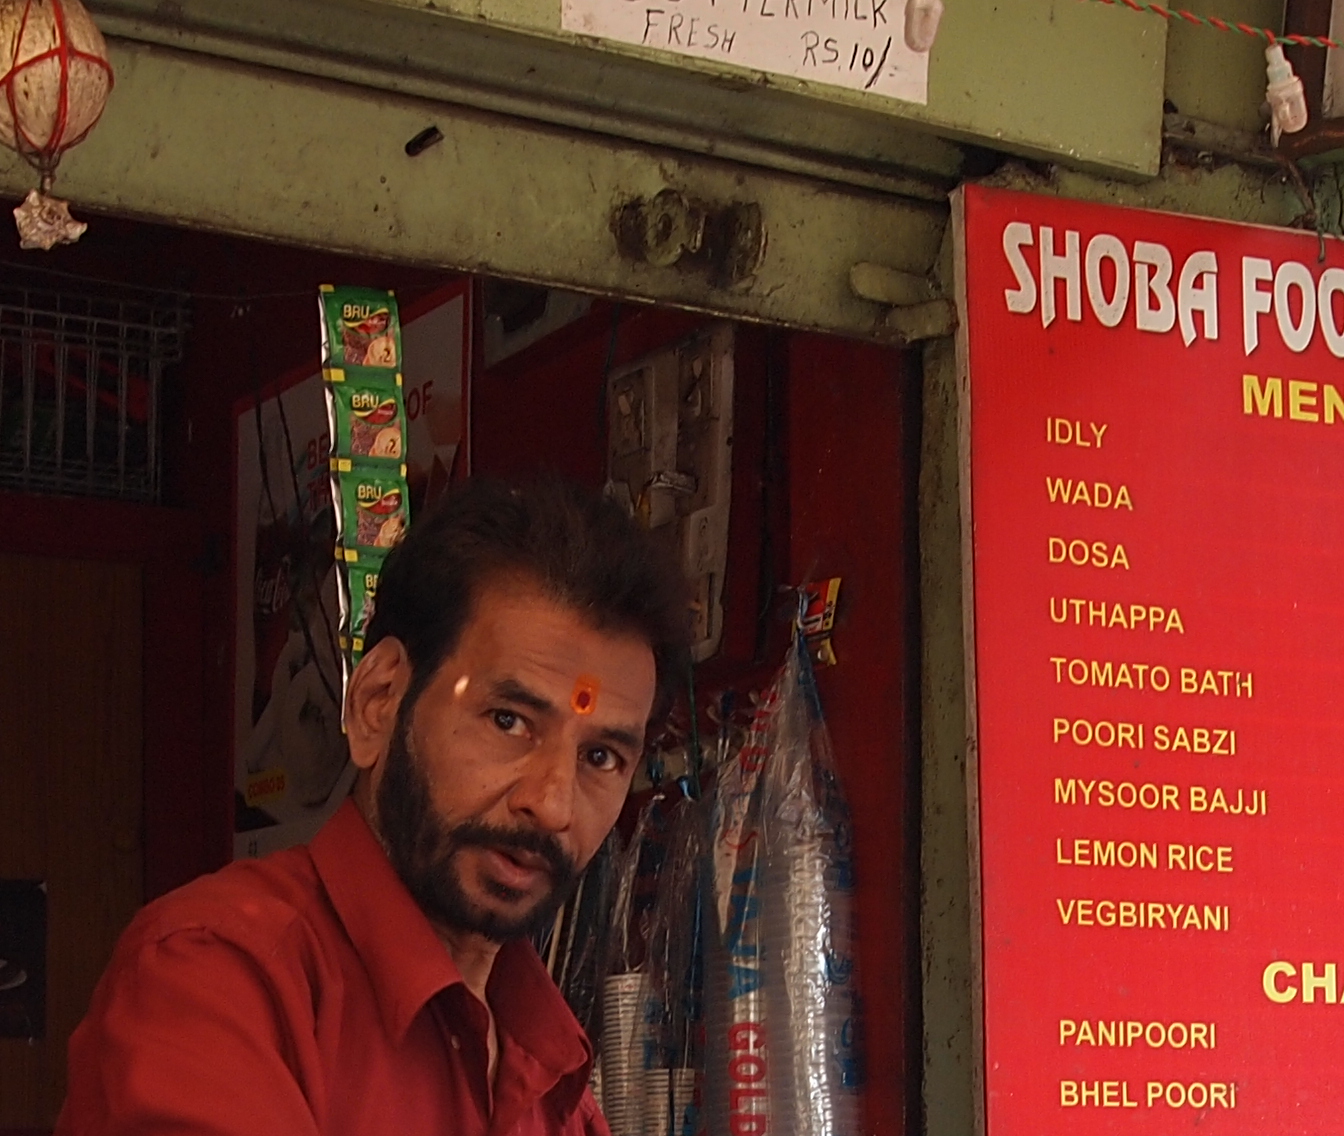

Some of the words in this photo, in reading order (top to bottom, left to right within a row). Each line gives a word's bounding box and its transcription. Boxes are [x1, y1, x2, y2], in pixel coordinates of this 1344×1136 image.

[641, 8, 737, 53] FRESH
[1003, 222, 1218, 347] SHOBA
[343, 304, 370, 319] BRU
[352, 394, 380, 409] BRU
[1047, 418, 1107, 448] IDLY
[357, 485, 382, 499] BRU
[1046, 477, 1133, 511] WADA
[1049, 537, 1130, 570] DOSA
[1050, 597, 1184, 634] UTHAPPA
[1050, 657, 1170, 691] TOMATO
[1180, 668, 1253, 698] BATH
[1053, 718, 1144, 749] POORI
[1154, 725, 1236, 755] SABZI
[1054, 778, 1180, 810] MYSOOR
[1190, 786, 1266, 815] BAJJI
[1056, 838, 1157, 869] LEMON
[1168, 844, 1234, 872] RICE
[1056, 899, 1229, 931] VEGBIRYANI
[1059, 1019, 1216, 1049] PANIPOORI
[1060, 1080, 1138, 1107] BHEL
[1147, 1082, 1236, 1109] POORI
